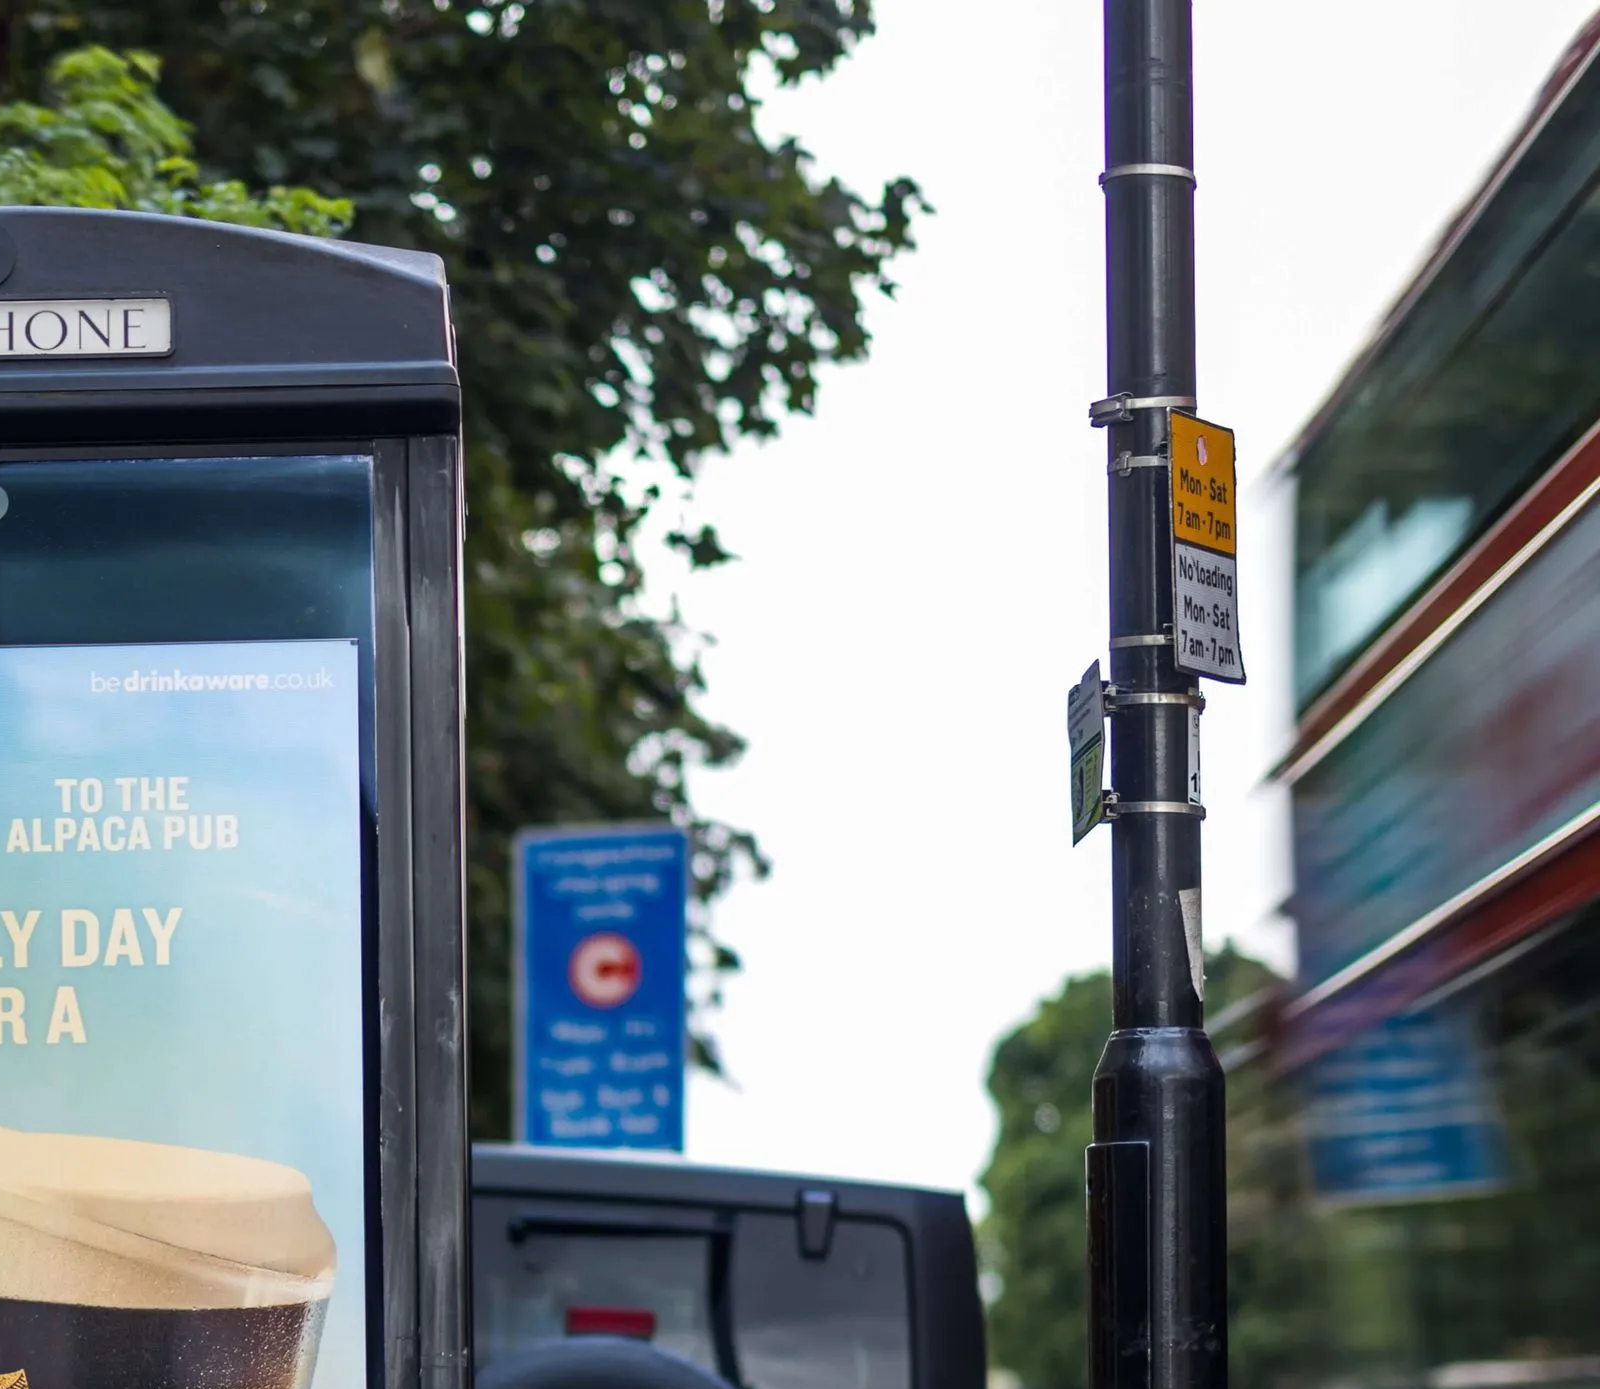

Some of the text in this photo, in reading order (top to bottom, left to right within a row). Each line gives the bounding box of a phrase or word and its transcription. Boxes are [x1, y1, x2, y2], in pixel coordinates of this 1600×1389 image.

[1179, 468, 1202, 496] Mon
[1209, 477, 1228, 505] Sat
[1179, 554, 1233, 597] No loading
[1183, 595, 1205, 625] Mon
[1212, 603, 1230, 631] Sat
[54, 777, 190, 813] TO THE
[6, 815, 239, 853] ALPACA PUB
[60, 907, 183, 967] DAY
[46, 985, 87, 1044] A
